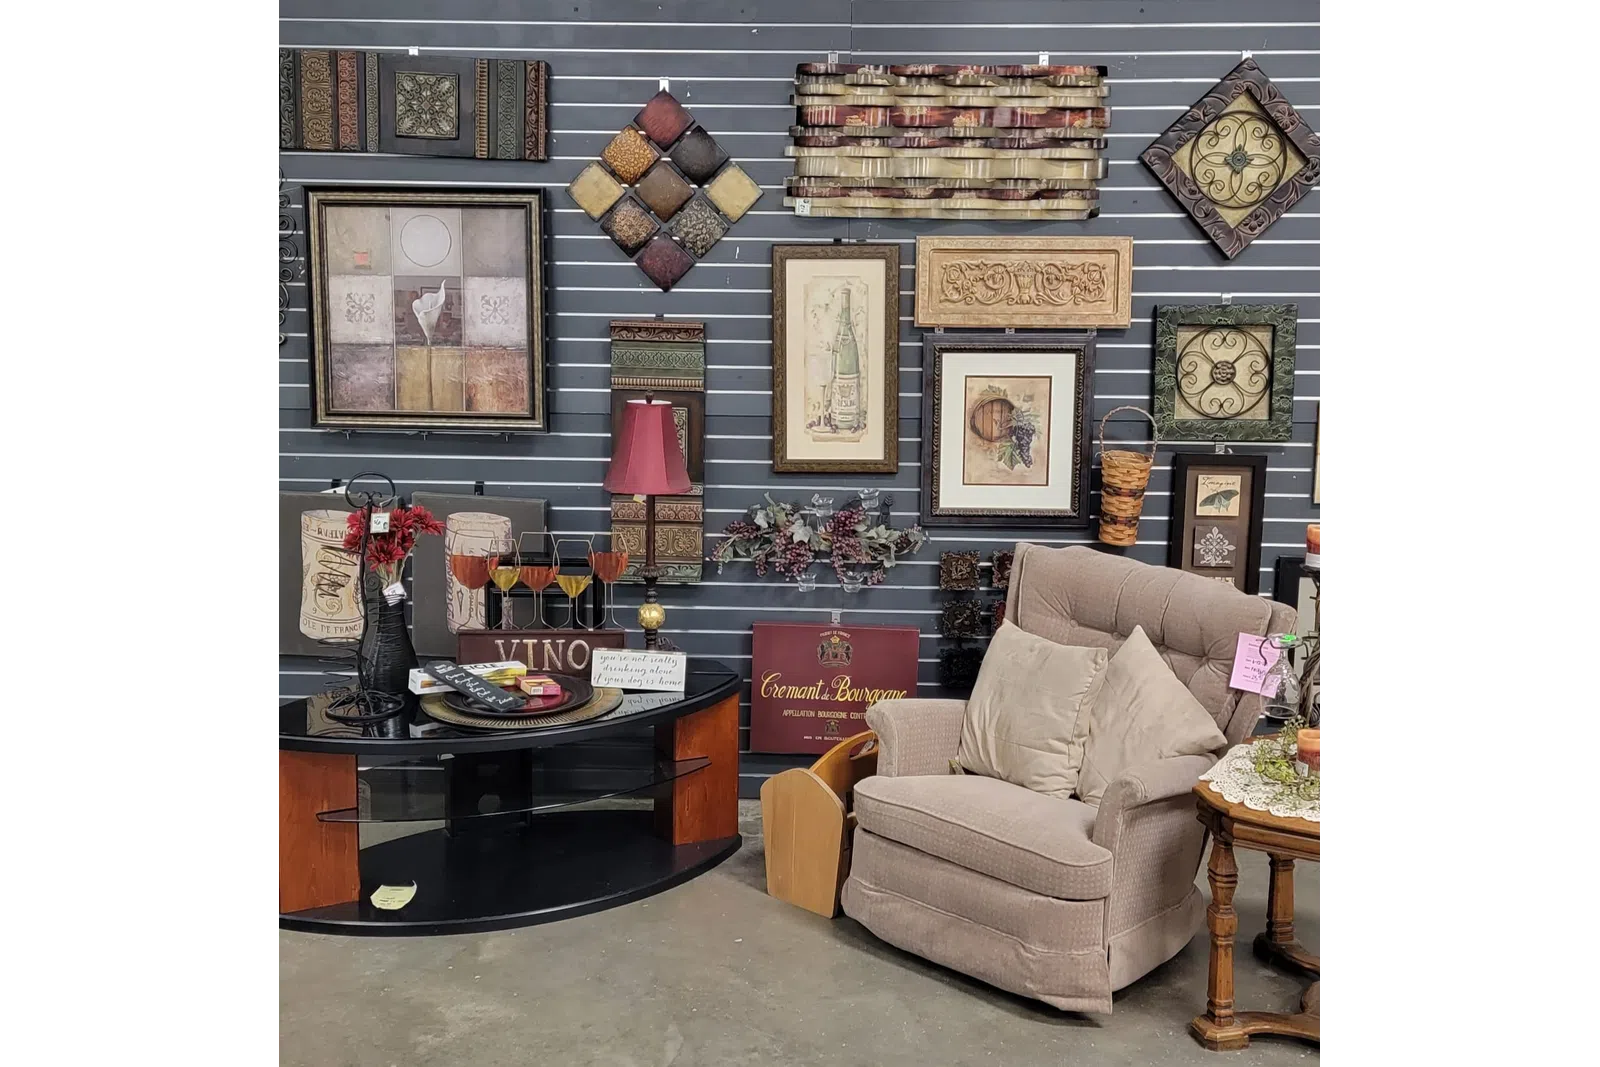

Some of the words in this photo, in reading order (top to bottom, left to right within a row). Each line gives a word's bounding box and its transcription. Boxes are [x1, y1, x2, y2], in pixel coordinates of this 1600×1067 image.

[494, 639, 590, 672] VINO
[600, 654, 627, 665] you're
[632, 655, 647, 663] not
[650, 656, 678, 668] really
[603, 664, 647, 677] drinking
[649, 666, 673, 675] alone
[593, 673, 602, 685] if
[604, 677, 624, 687] your
[628, 677, 643, 688] dog
[658, 677, 682, 687] home
[760, 669, 825, 701] Cremant
[821, 687, 831, 701] de
[831, 675, 907, 710] Bourgogne
[782, 709, 816, 718] APPELLATION
[817, 711, 848, 719] BOURGOGNE
